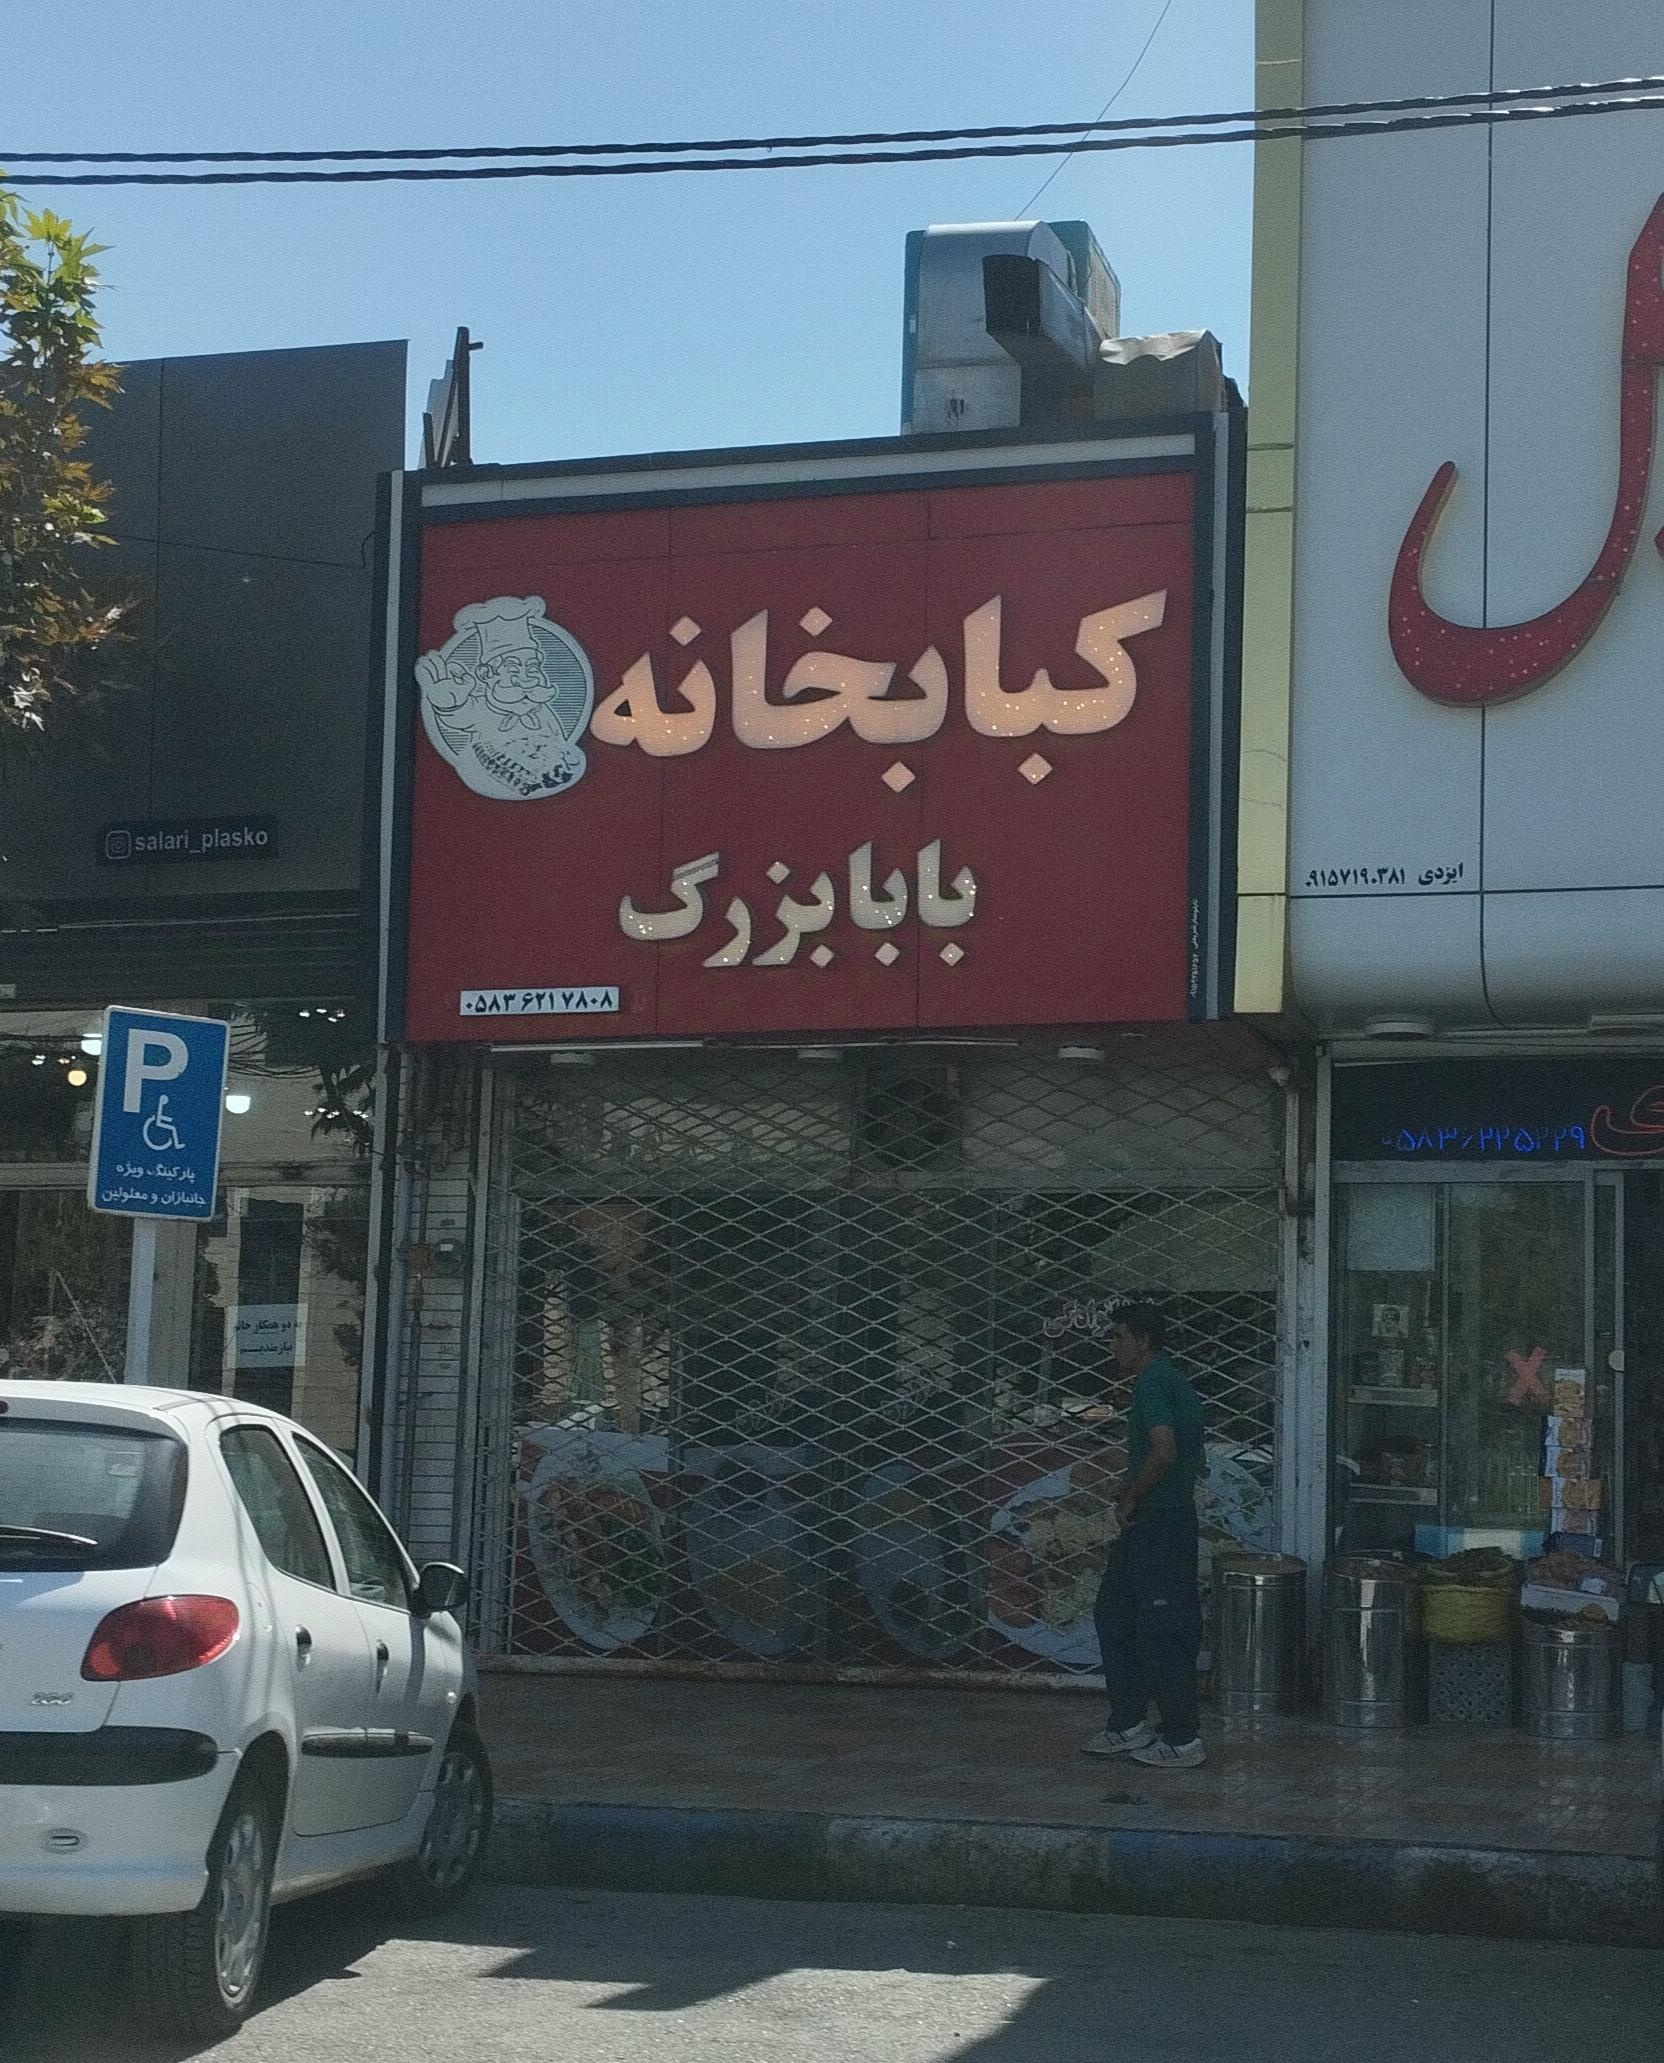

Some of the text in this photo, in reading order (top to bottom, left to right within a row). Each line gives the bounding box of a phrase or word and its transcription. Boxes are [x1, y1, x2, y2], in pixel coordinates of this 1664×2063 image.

[135, 827, 268, 854] salari_plasko
[1417, 862, 1465, 886] ایزدی
[122, 1028, 190, 1113] P
[116, 1160, 196, 1184] پارکینگ ویژه
[102, 1187, 207, 1207] جانبازان و معلولین
